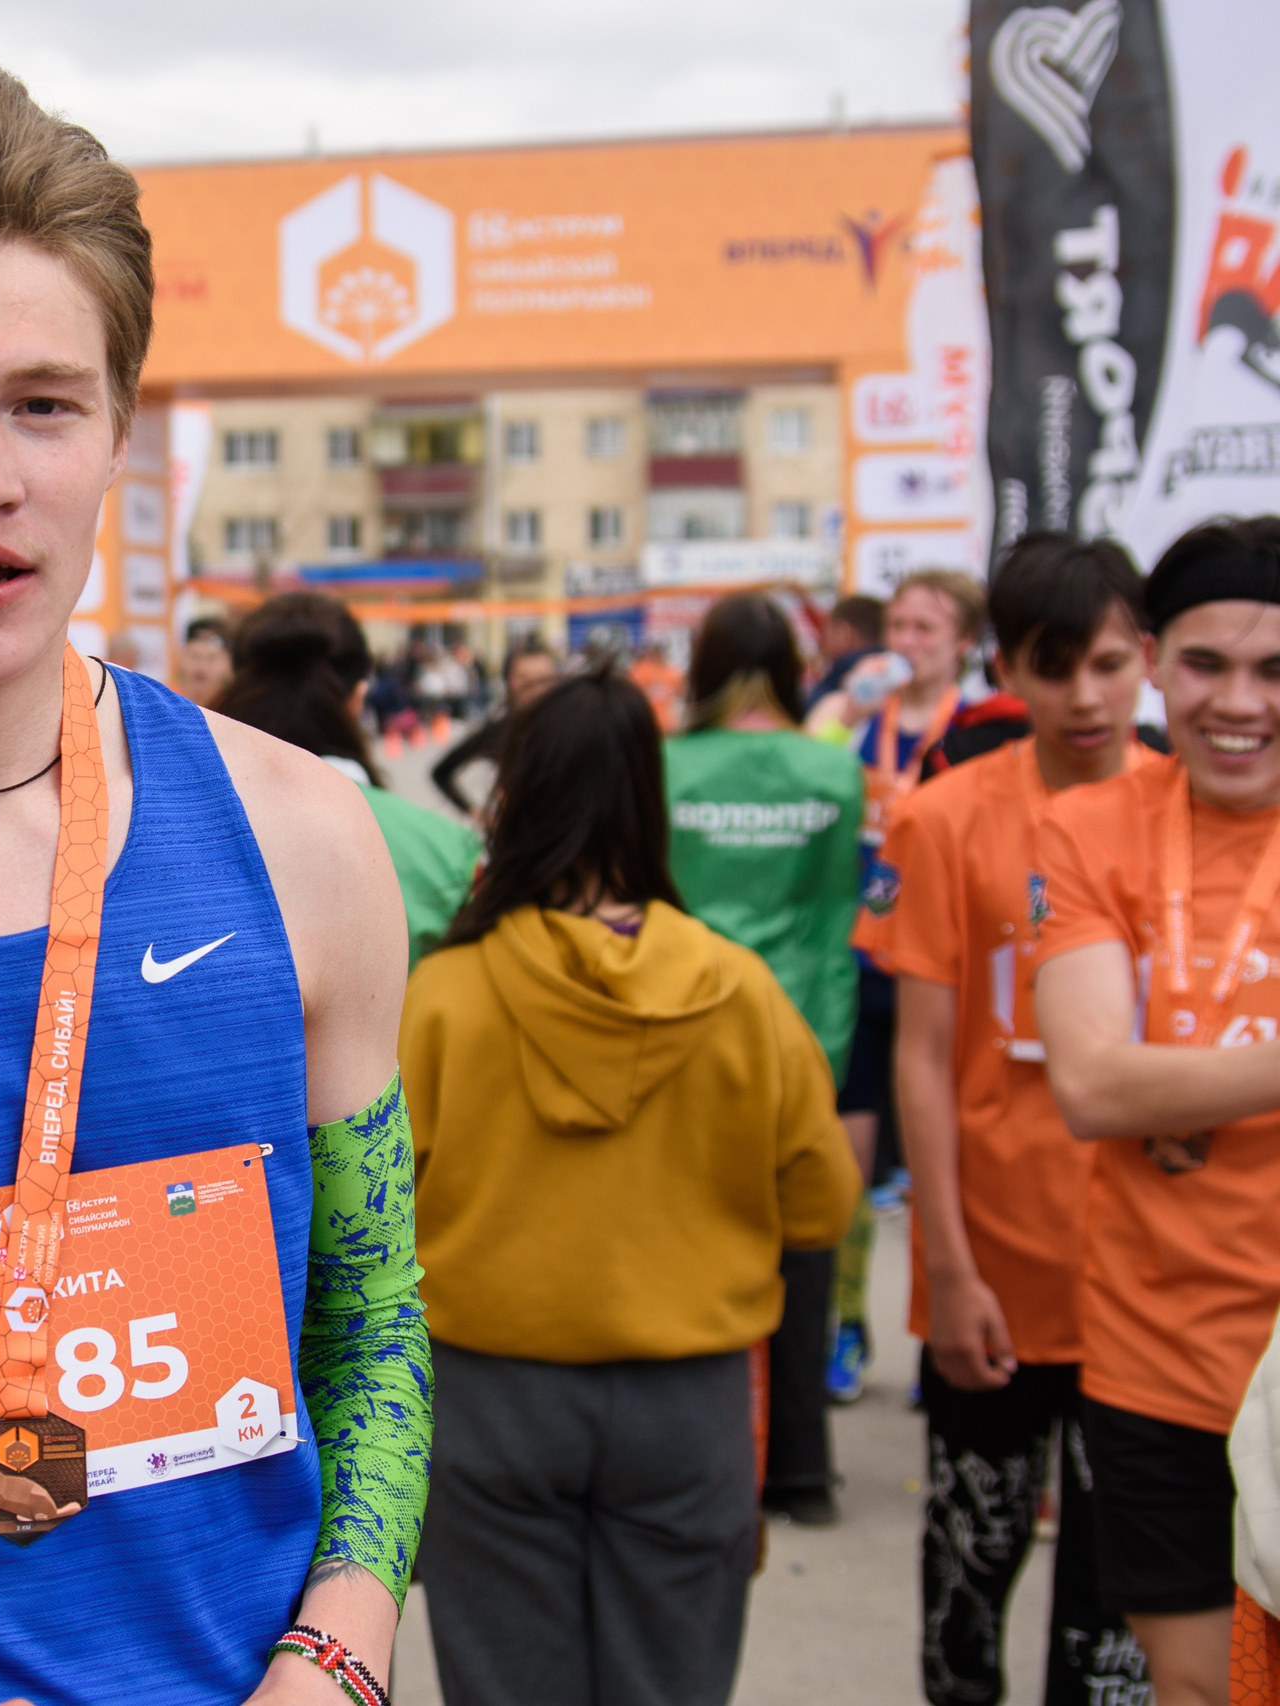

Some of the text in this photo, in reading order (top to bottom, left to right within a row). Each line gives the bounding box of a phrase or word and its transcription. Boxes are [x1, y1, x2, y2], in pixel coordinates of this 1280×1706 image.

[39, 990, 78, 1164] ВПЕРЕД, СИБАЙ!
[81, 1196, 118, 1209] АСТРУМ
[68, 1208, 118, 1226] СИБАЙСКИЙ
[70, 1218, 131, 1236] ПОЛУМАРАФОН
[18, 1220, 30, 1265] АСТРУМ
[44, 1212, 60, 1285] ПОЛУМАРАФОН
[33, 1224, 47, 1284] СИБАЙСКИЙ
[238, 1393, 257, 1419] 2
[238, 1424, 264, 1442] КМ
[87, 1477, 116, 1489] ИБАЙ!
